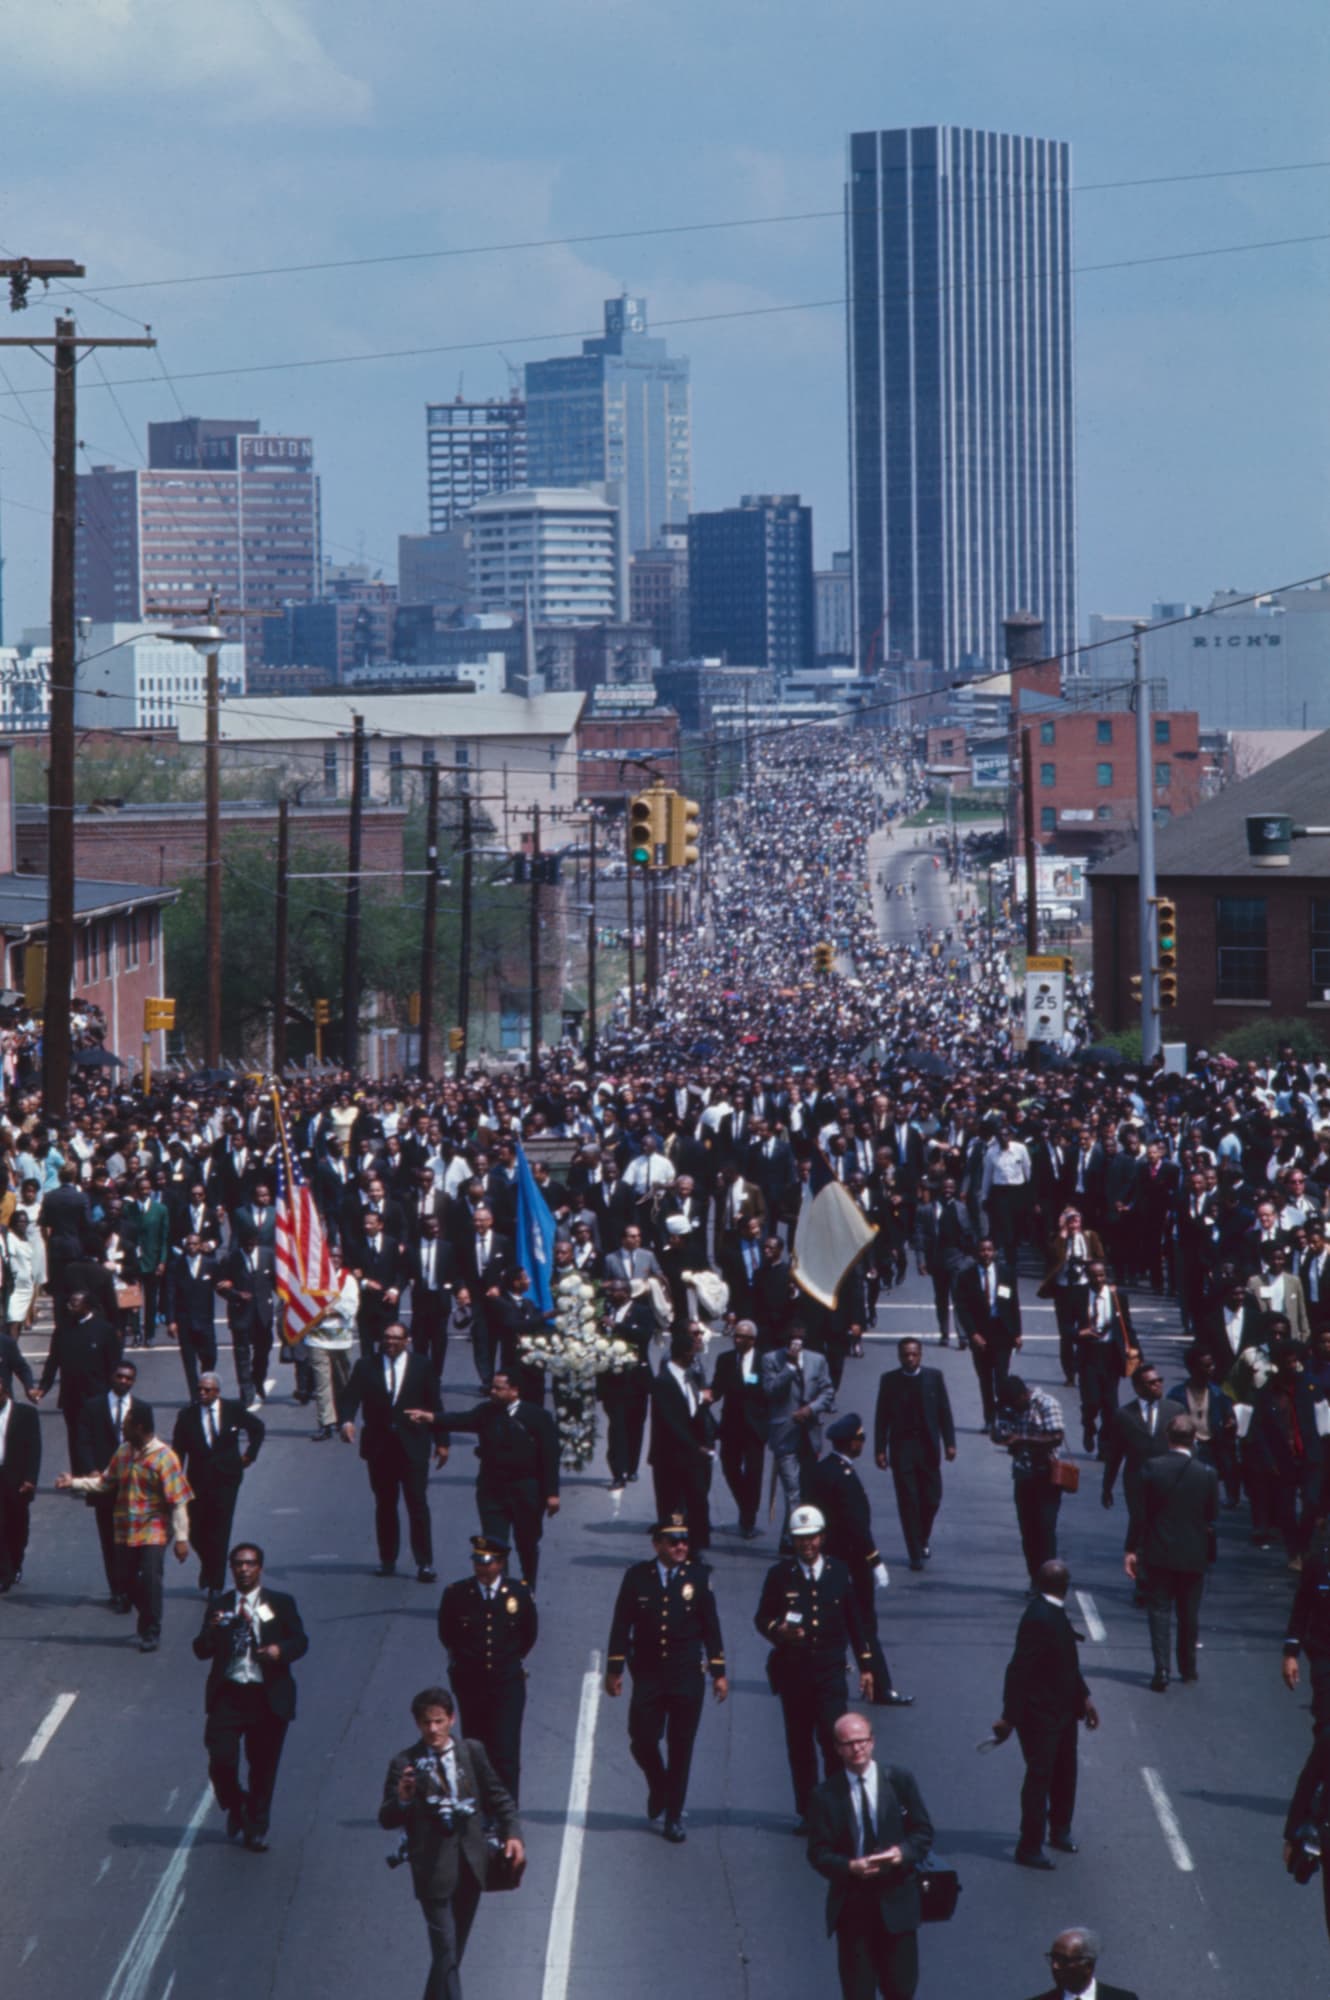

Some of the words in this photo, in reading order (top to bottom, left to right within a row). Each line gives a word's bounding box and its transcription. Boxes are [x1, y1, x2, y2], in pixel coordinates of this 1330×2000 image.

[243, 440, 312, 457] FULTON
[1192, 633, 1281, 648] RICH'S
[1034, 995, 1057, 1010] 25
